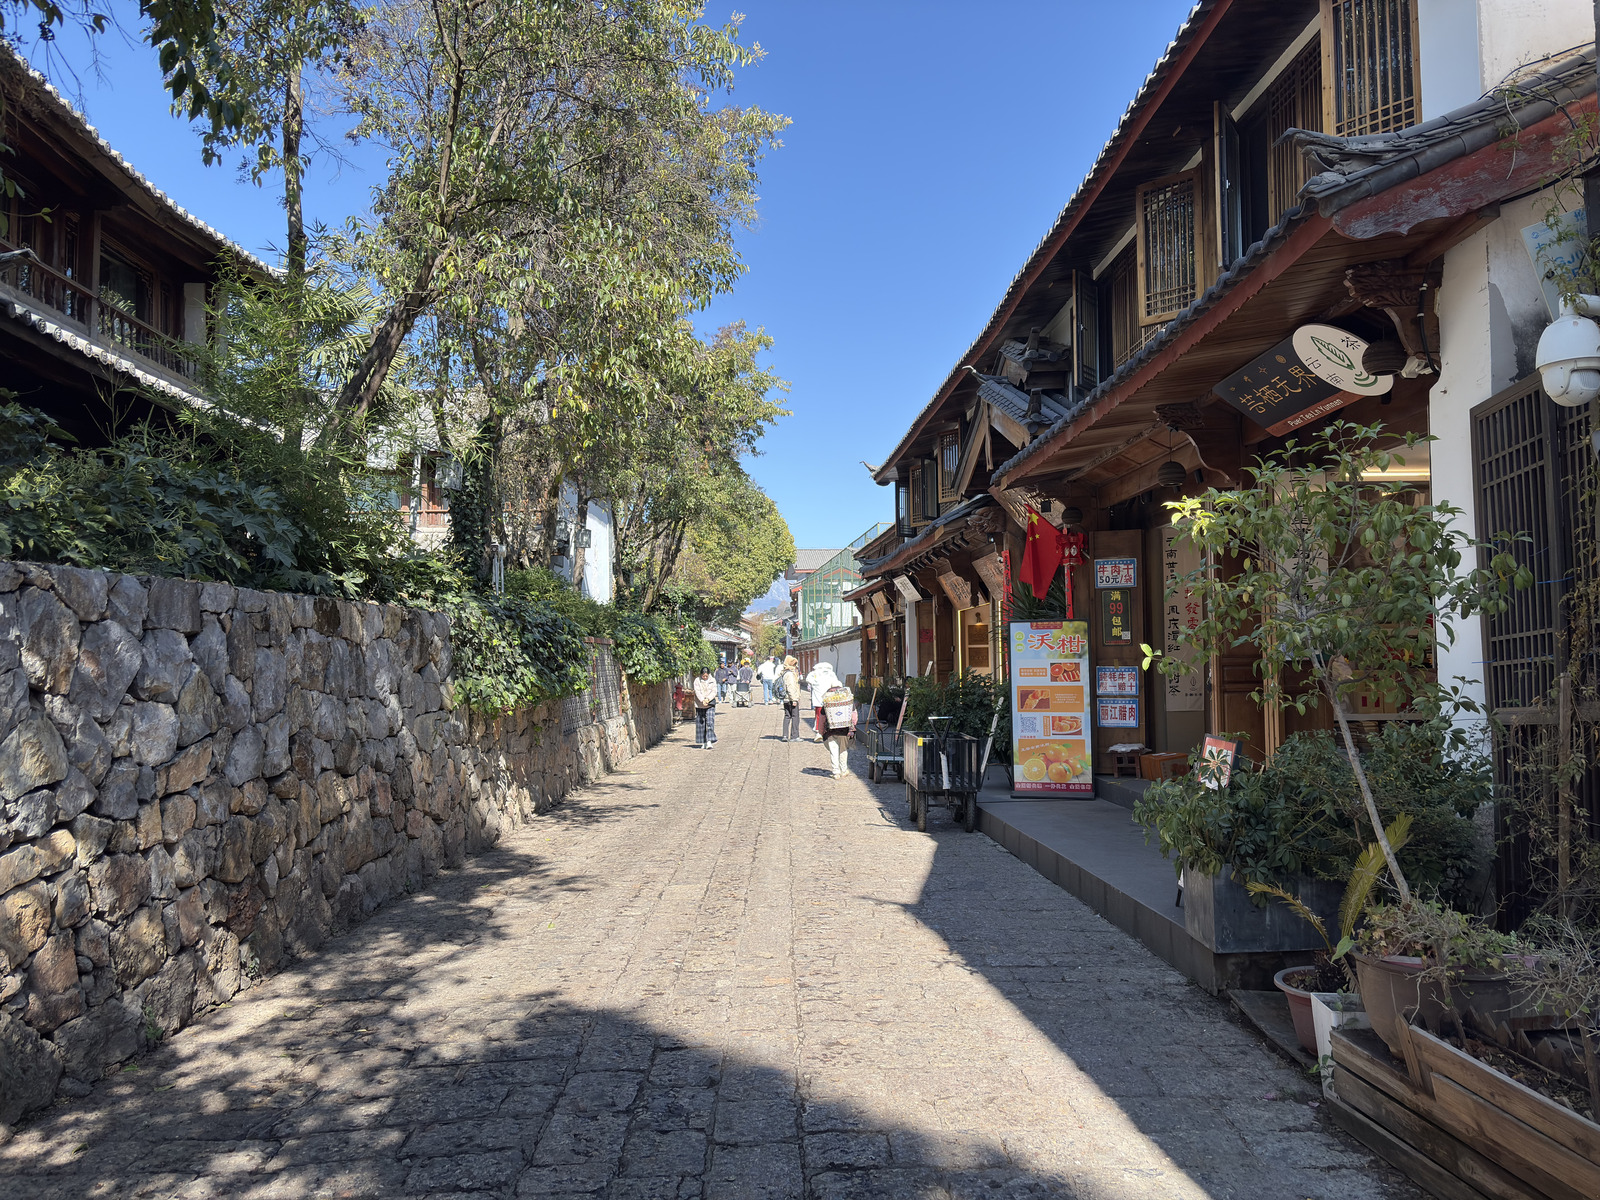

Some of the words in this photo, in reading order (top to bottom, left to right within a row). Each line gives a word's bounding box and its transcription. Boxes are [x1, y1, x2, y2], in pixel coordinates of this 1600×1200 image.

[1341, 336, 1361, 350] 茶
[1317, 399, 1344, 412] Yunnan
[1098, 564, 1133, 576] 牛肉干
[1099, 575, 1133, 584] 50元/袋
[1027, 632, 1087, 654] 沃柑
[1100, 705, 1136, 721] 丽江腊肉
